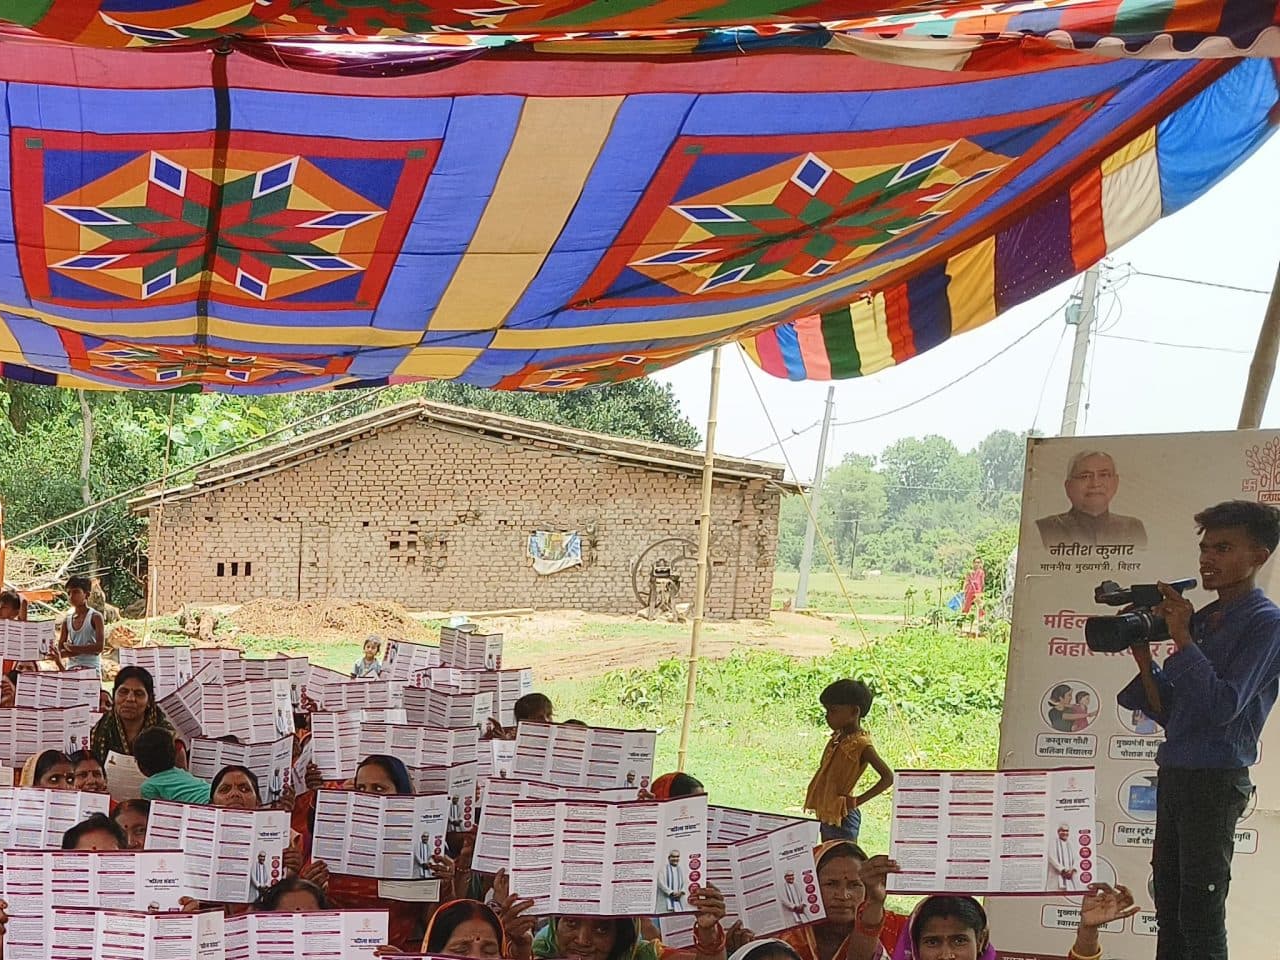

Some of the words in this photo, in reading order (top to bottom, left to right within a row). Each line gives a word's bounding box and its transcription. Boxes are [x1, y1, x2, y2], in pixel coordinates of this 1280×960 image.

[1049, 543, 1093, 557] नीतीश
[1096, 544, 1135, 560] कुमार
[1040, 561, 1071, 571] माननीय
[1118, 561, 1141, 571] बिहार
[1039, 747, 1064, 755] बालिका
[1118, 825, 1135, 834] बिहार
